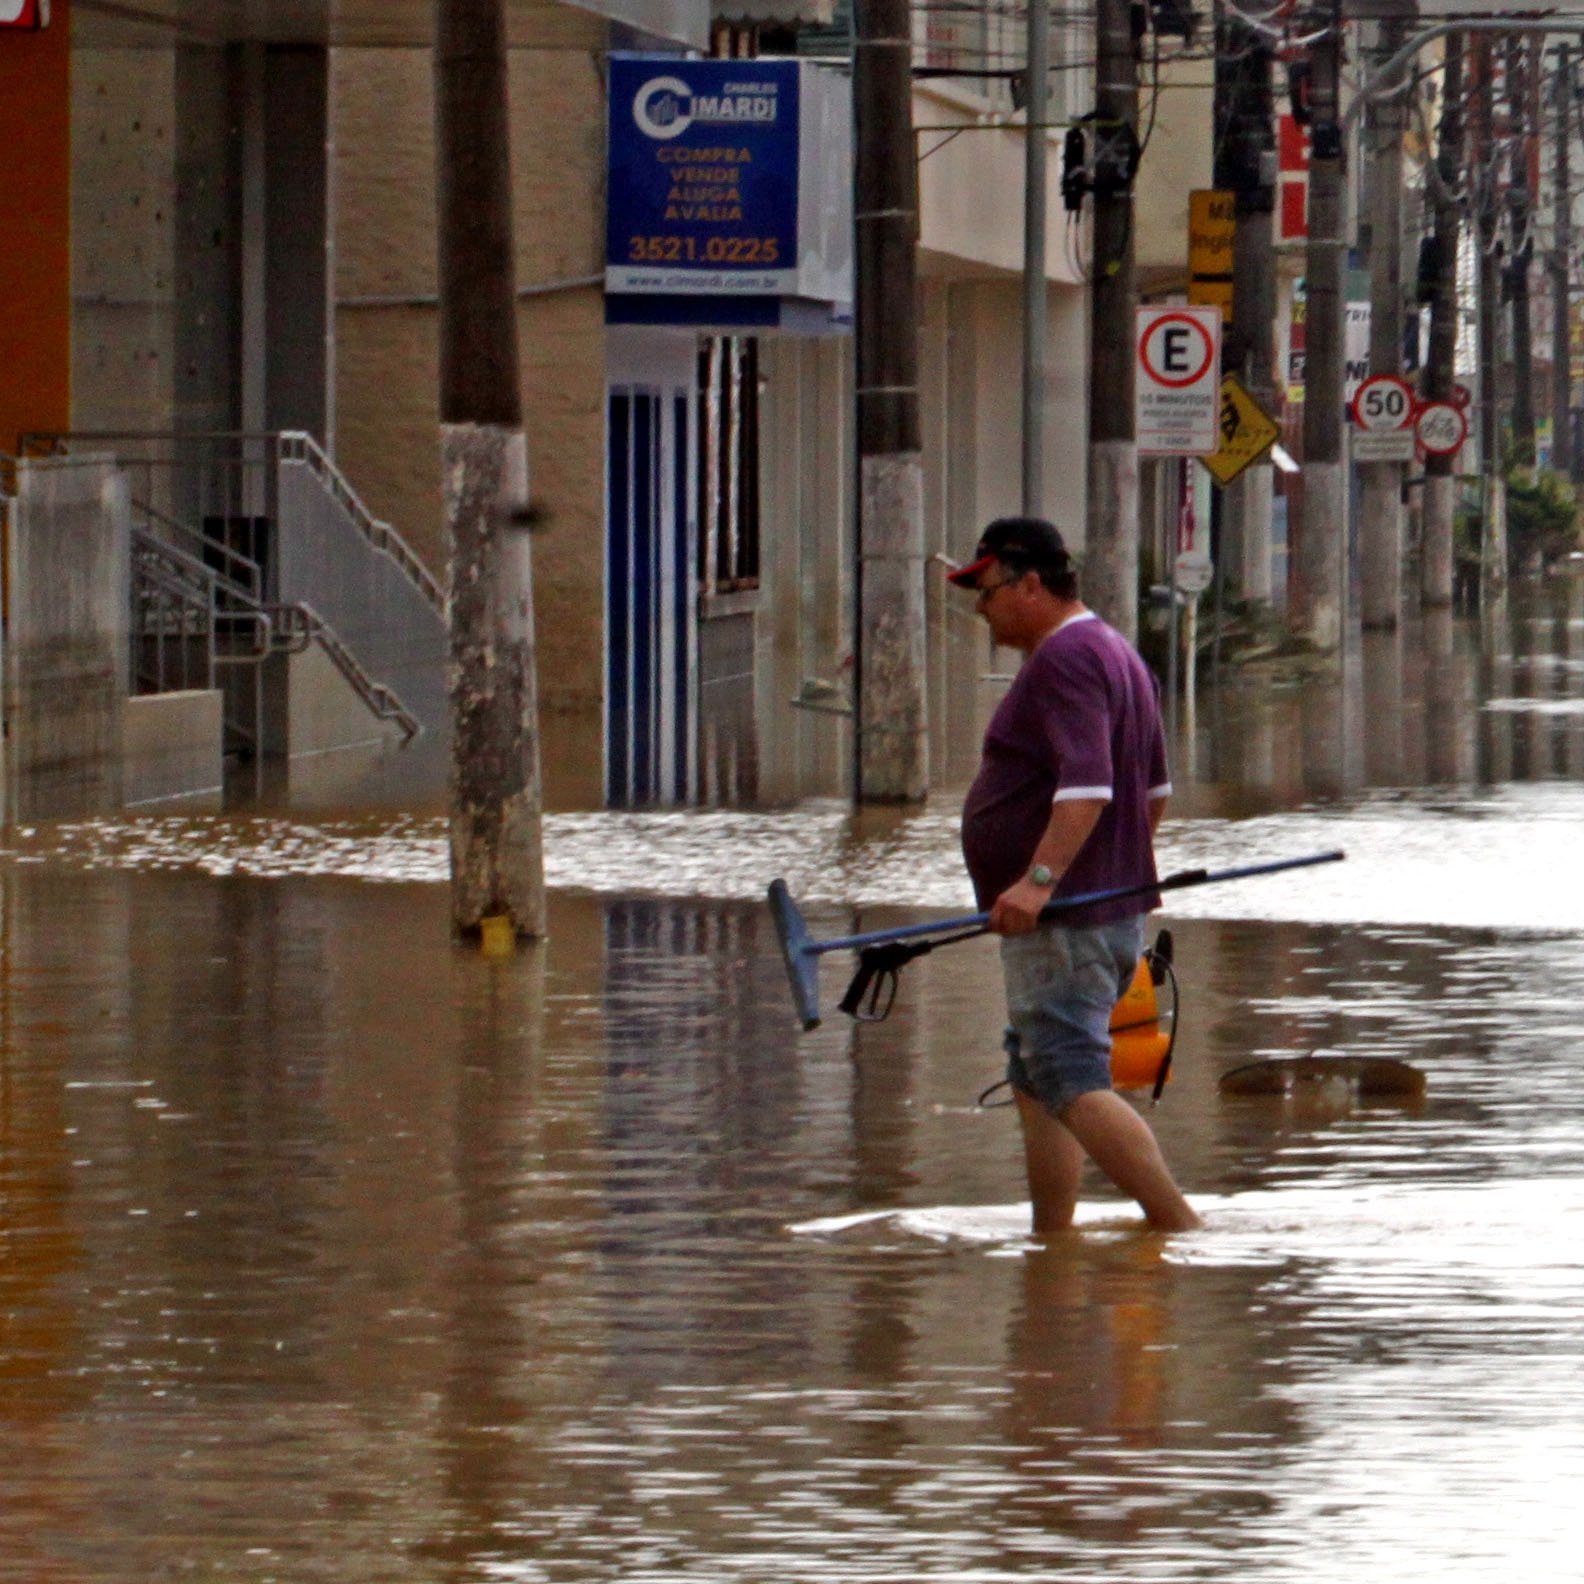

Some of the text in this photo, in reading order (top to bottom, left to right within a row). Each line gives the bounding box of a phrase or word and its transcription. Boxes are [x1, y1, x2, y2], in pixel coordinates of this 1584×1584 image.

[657, 147, 751, 163] COMPRA
[671, 167, 739, 182] VENDE
[667, 186, 740, 201] ALUGA
[629, 236, 779, 262] 3521.0225
[1164, 329, 1189, 371] E
[1366, 390, 1403, 416] 50
